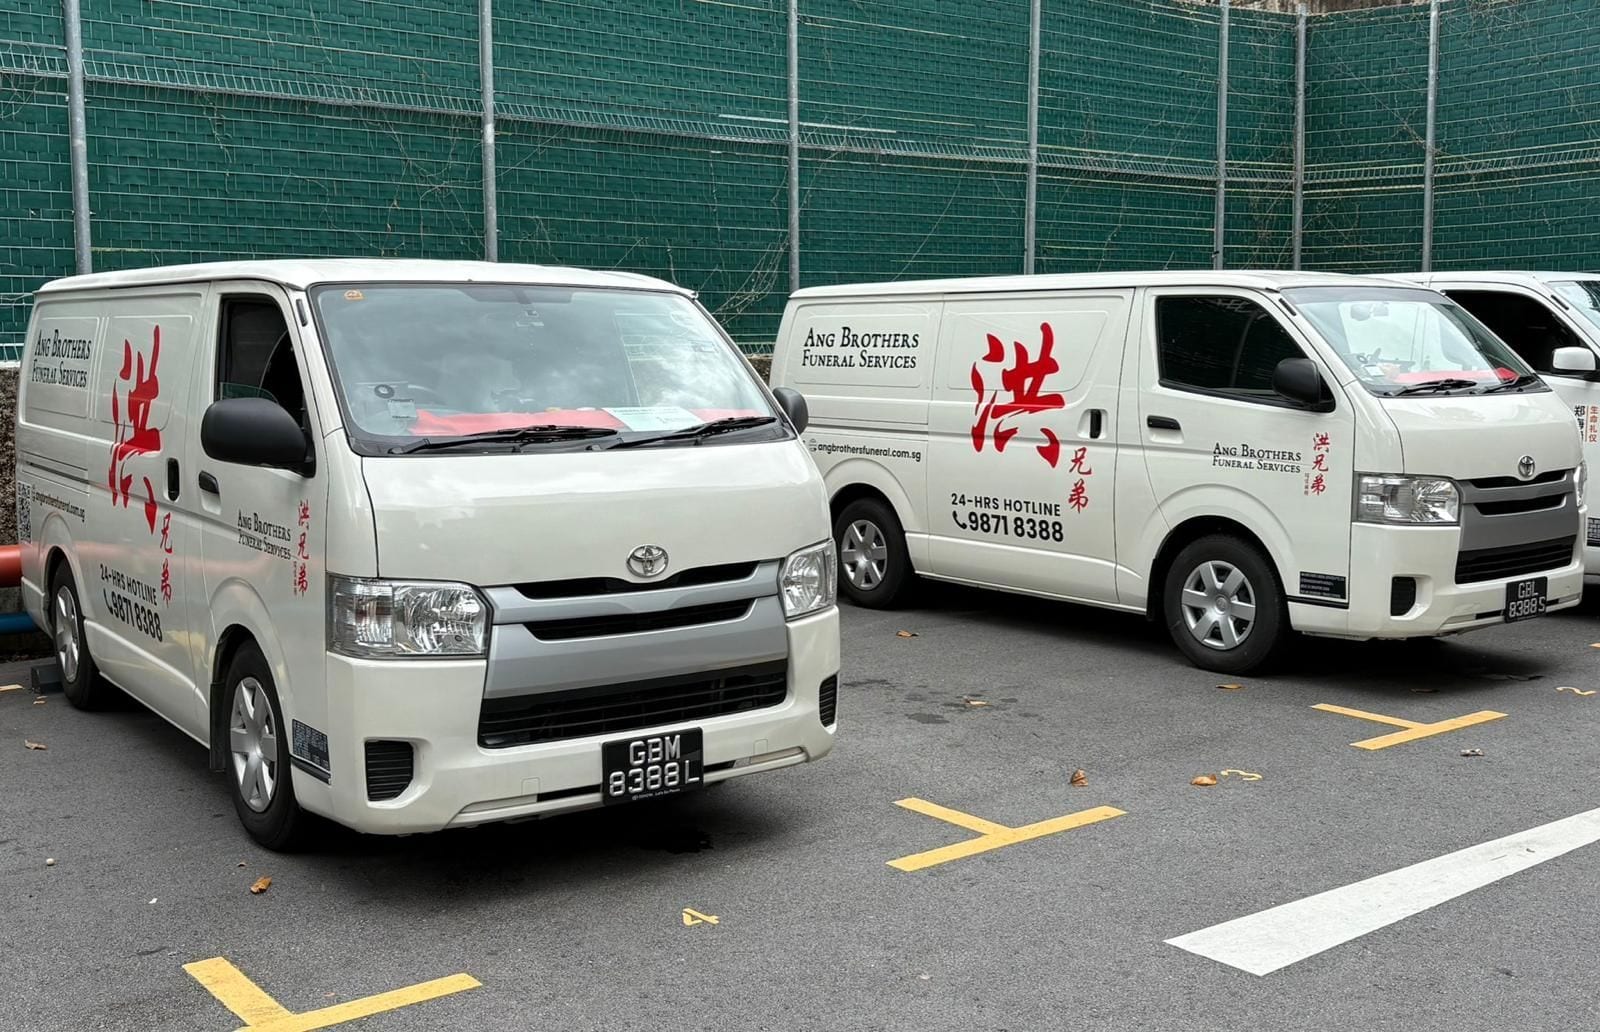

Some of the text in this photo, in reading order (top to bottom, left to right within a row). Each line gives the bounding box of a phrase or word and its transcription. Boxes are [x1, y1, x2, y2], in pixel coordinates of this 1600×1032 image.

[35, 329, 92, 360] ANG BROTHERS
[804, 326, 920, 349] ANG BROTHERS
[32, 359, 88, 388] FUNERAL SERVICES
[802, 349, 917, 369] FUNERAL SERVICES
[971, 322, 1065, 468] 洪
[109, 325, 160, 534] 洪
[818, 443, 921, 462] angbrothersfuneral.com.sg
[1212, 455, 1301, 473] FUNERAL SERVICES
[1213, 442, 1302, 462] ANG BROTHERS
[1068, 447, 1093, 514] 兄弟
[951, 493, 1061, 517] 24-HRS HOTLINE
[237, 508, 292, 542] ANG BROTHERS
[967, 511, 1064, 543] 9871 8388
[100, 563, 158, 607] 24-HRS HOTLINE
[1518, 581, 1539, 598] GBL
[134, 602, 163, 643] 8388
[1509, 598, 1537, 618] 8388
[629, 734, 681, 767] GBM
[609, 761, 680, 797] 8388
[684, 759, 700, 785] L
